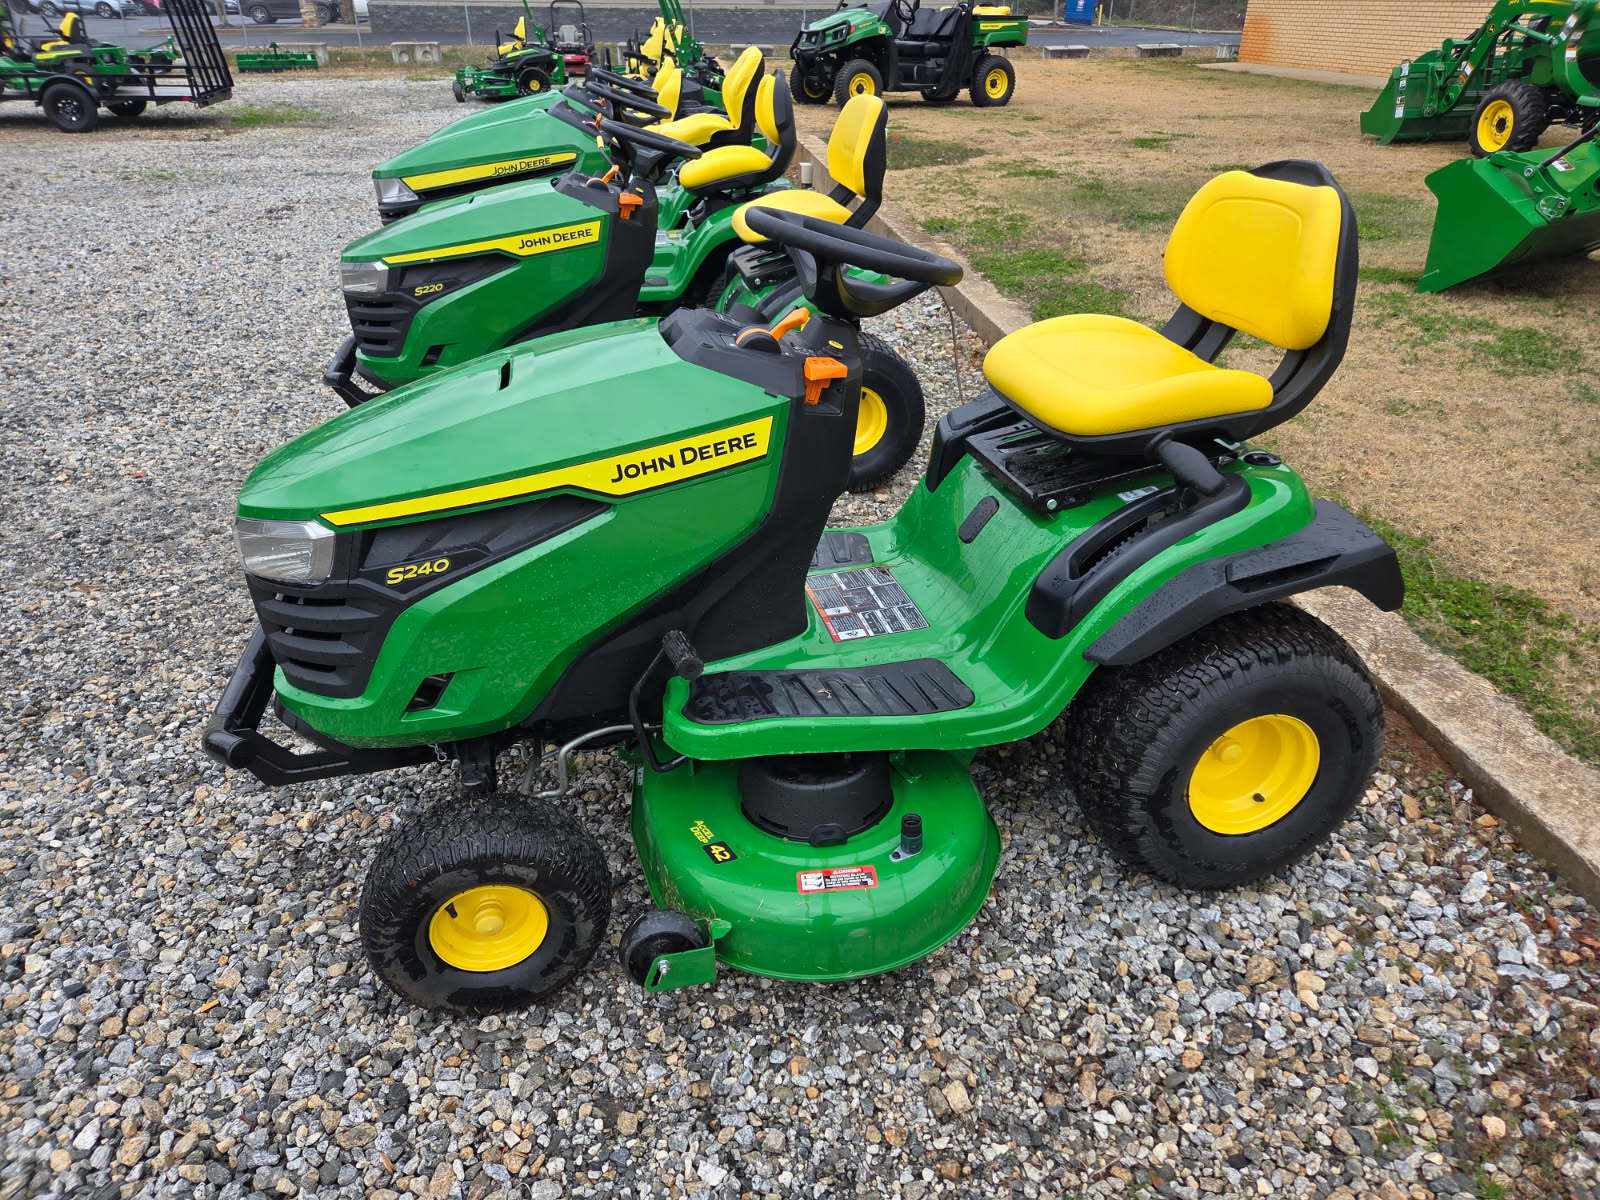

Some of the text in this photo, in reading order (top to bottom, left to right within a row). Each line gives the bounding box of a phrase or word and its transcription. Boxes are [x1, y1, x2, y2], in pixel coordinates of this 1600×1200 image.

[492, 157, 551, 175] JOHN DEERE
[518, 228, 593, 250] JOHN DEERE
[414, 283, 443, 296] S220
[611, 432, 758, 483] JOHN DEERE
[386, 558, 450, 585] S240
[710, 845, 731, 862] 42
